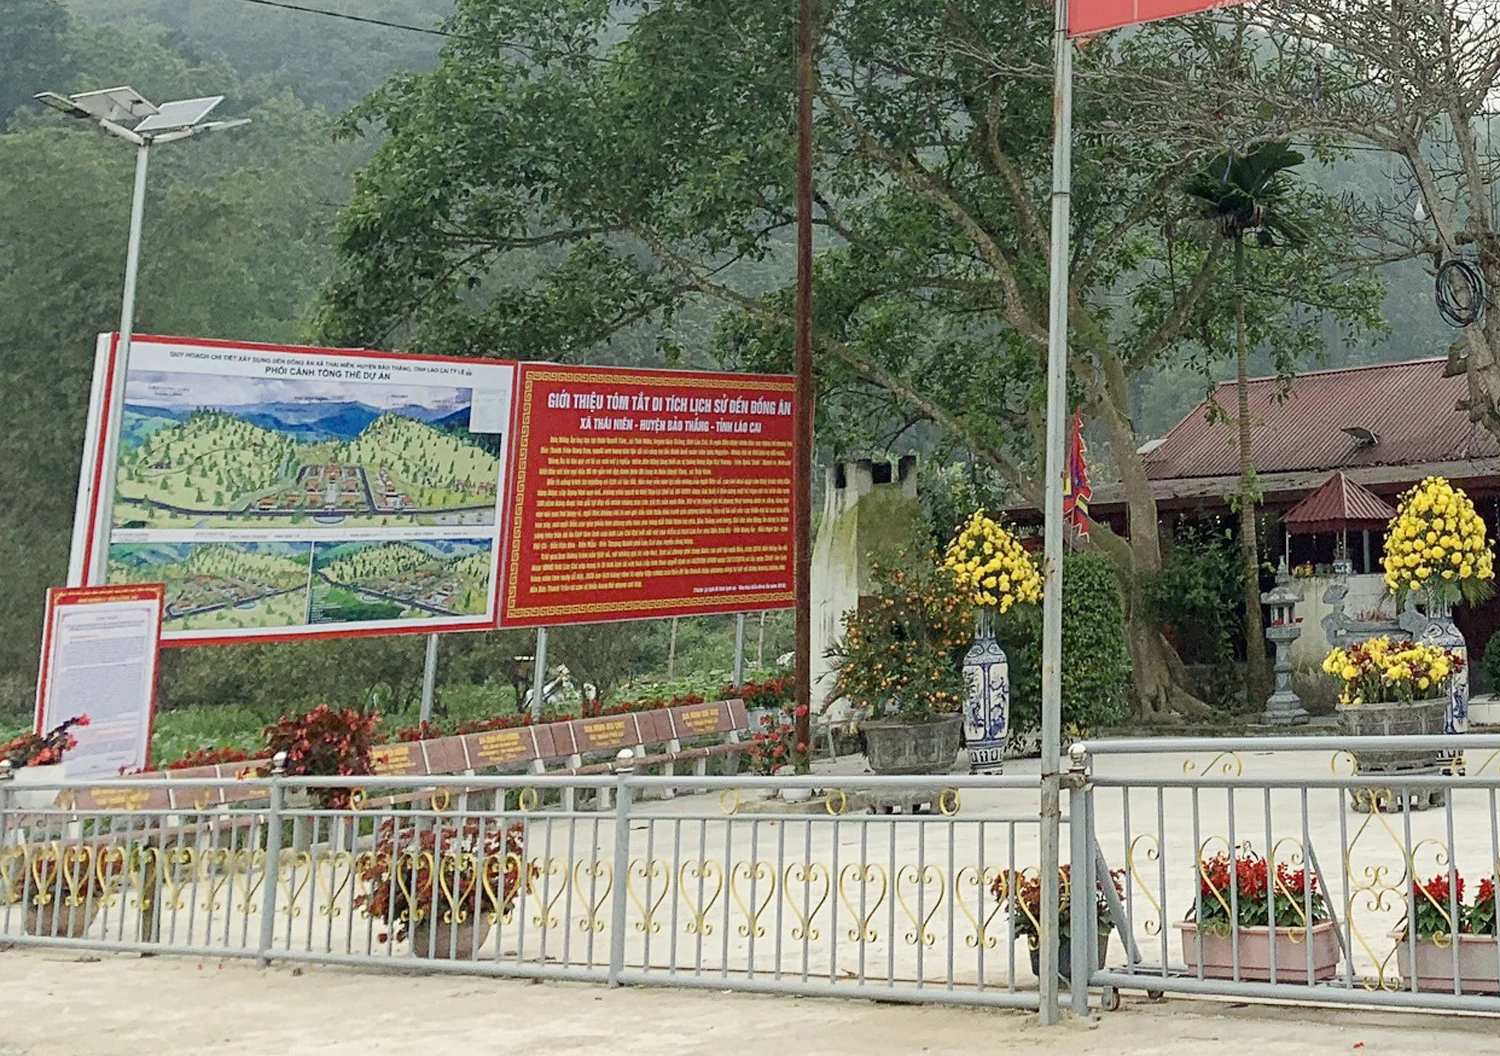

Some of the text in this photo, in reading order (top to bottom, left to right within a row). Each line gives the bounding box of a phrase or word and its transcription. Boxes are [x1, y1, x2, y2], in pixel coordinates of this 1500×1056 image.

[548, 389, 570, 409] GIỚI
[573, 391, 603, 413] THIỆU
[606, 392, 629, 410] TÓM
[632, 391, 650, 411] TẮT
[652, 396, 663, 411] DI
[665, 394, 687, 412] TÍCH
[690, 397, 712, 416] LỊCH
[714, 393, 729, 414] SỬ
